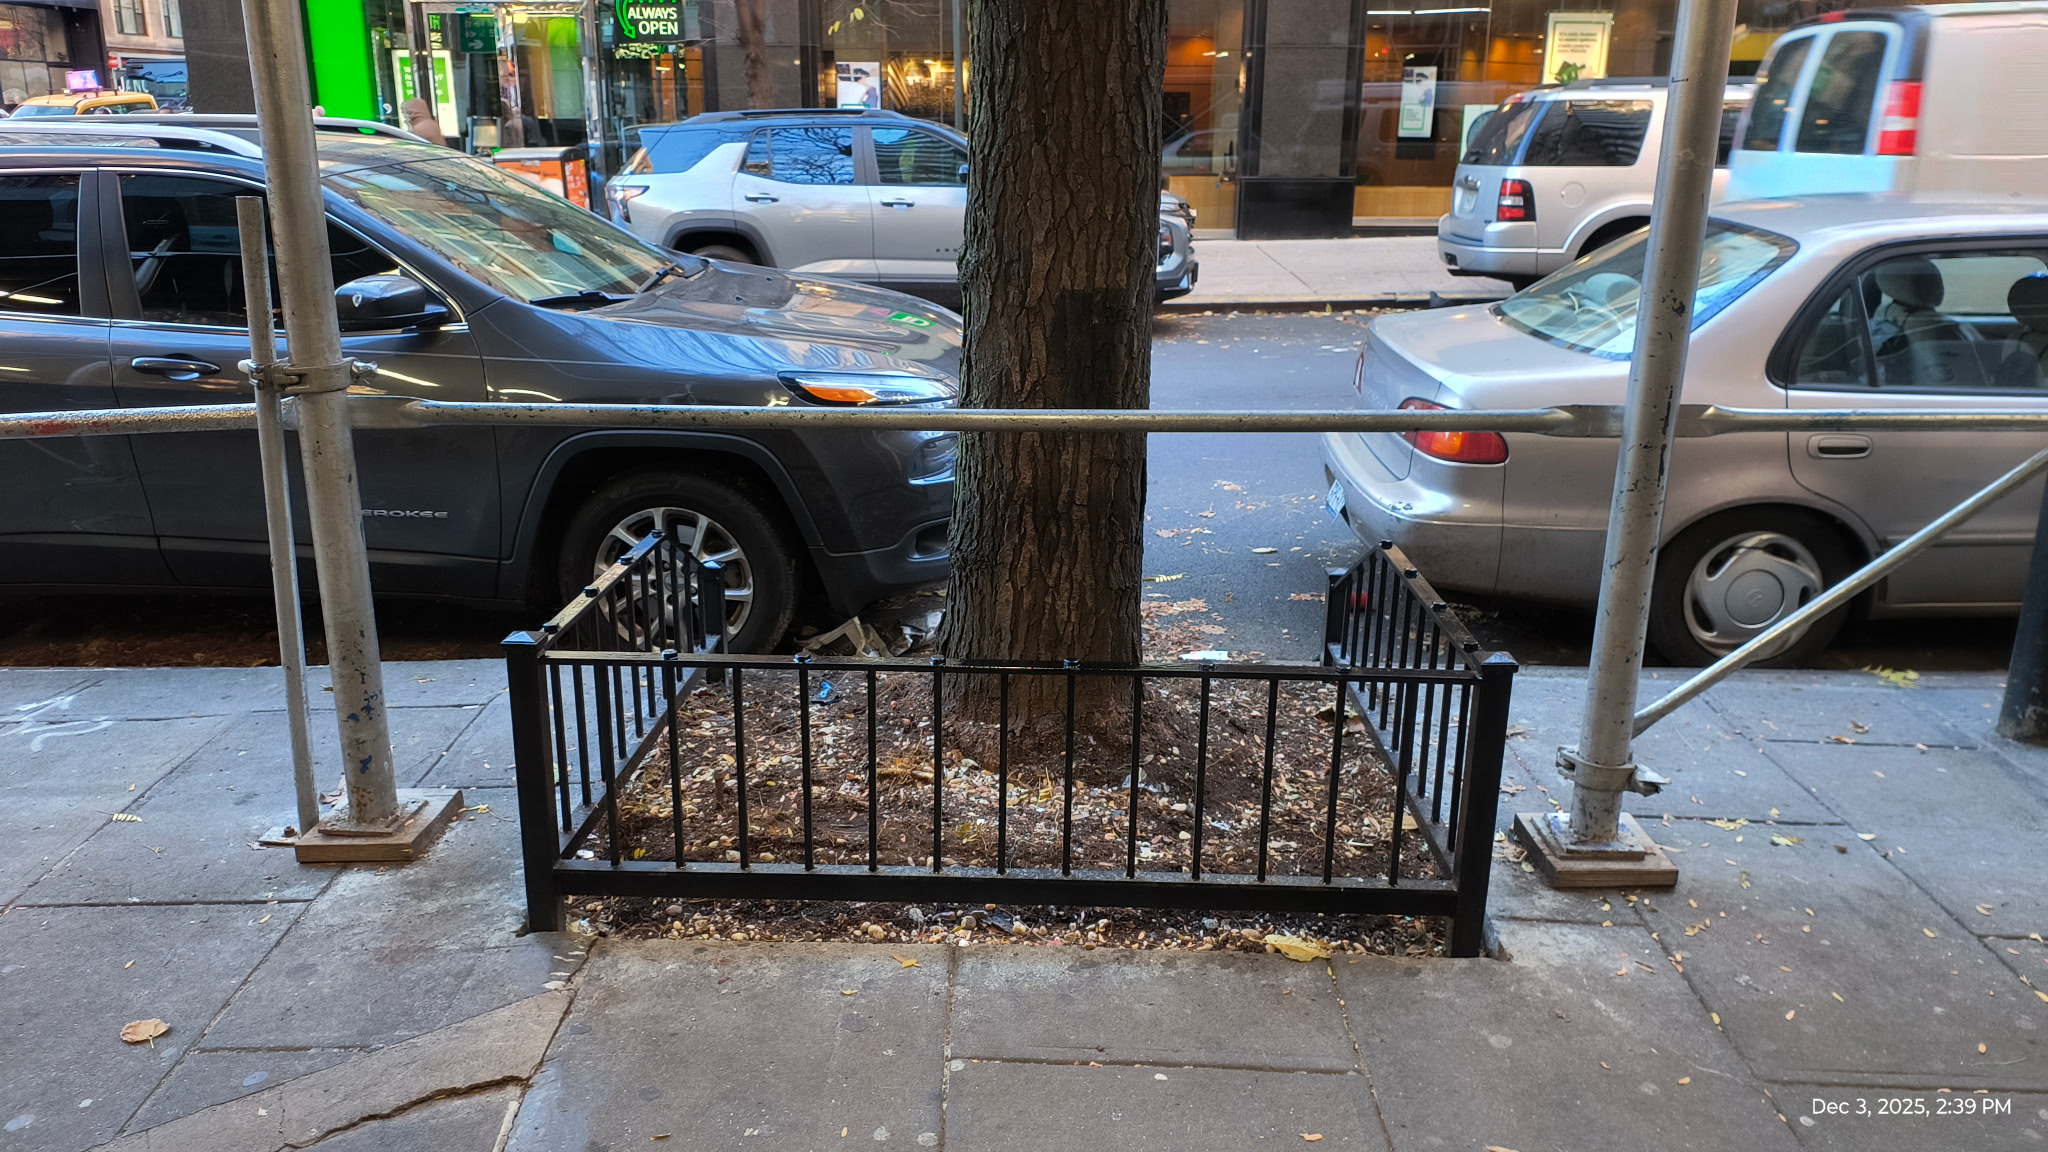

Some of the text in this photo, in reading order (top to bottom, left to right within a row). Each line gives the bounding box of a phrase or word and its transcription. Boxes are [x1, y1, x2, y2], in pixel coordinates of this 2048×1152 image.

[627, 7, 678, 20] ALWAYS
[638, 20, 679, 35] OPEN
[360, 509, 449, 519] EROKEE
